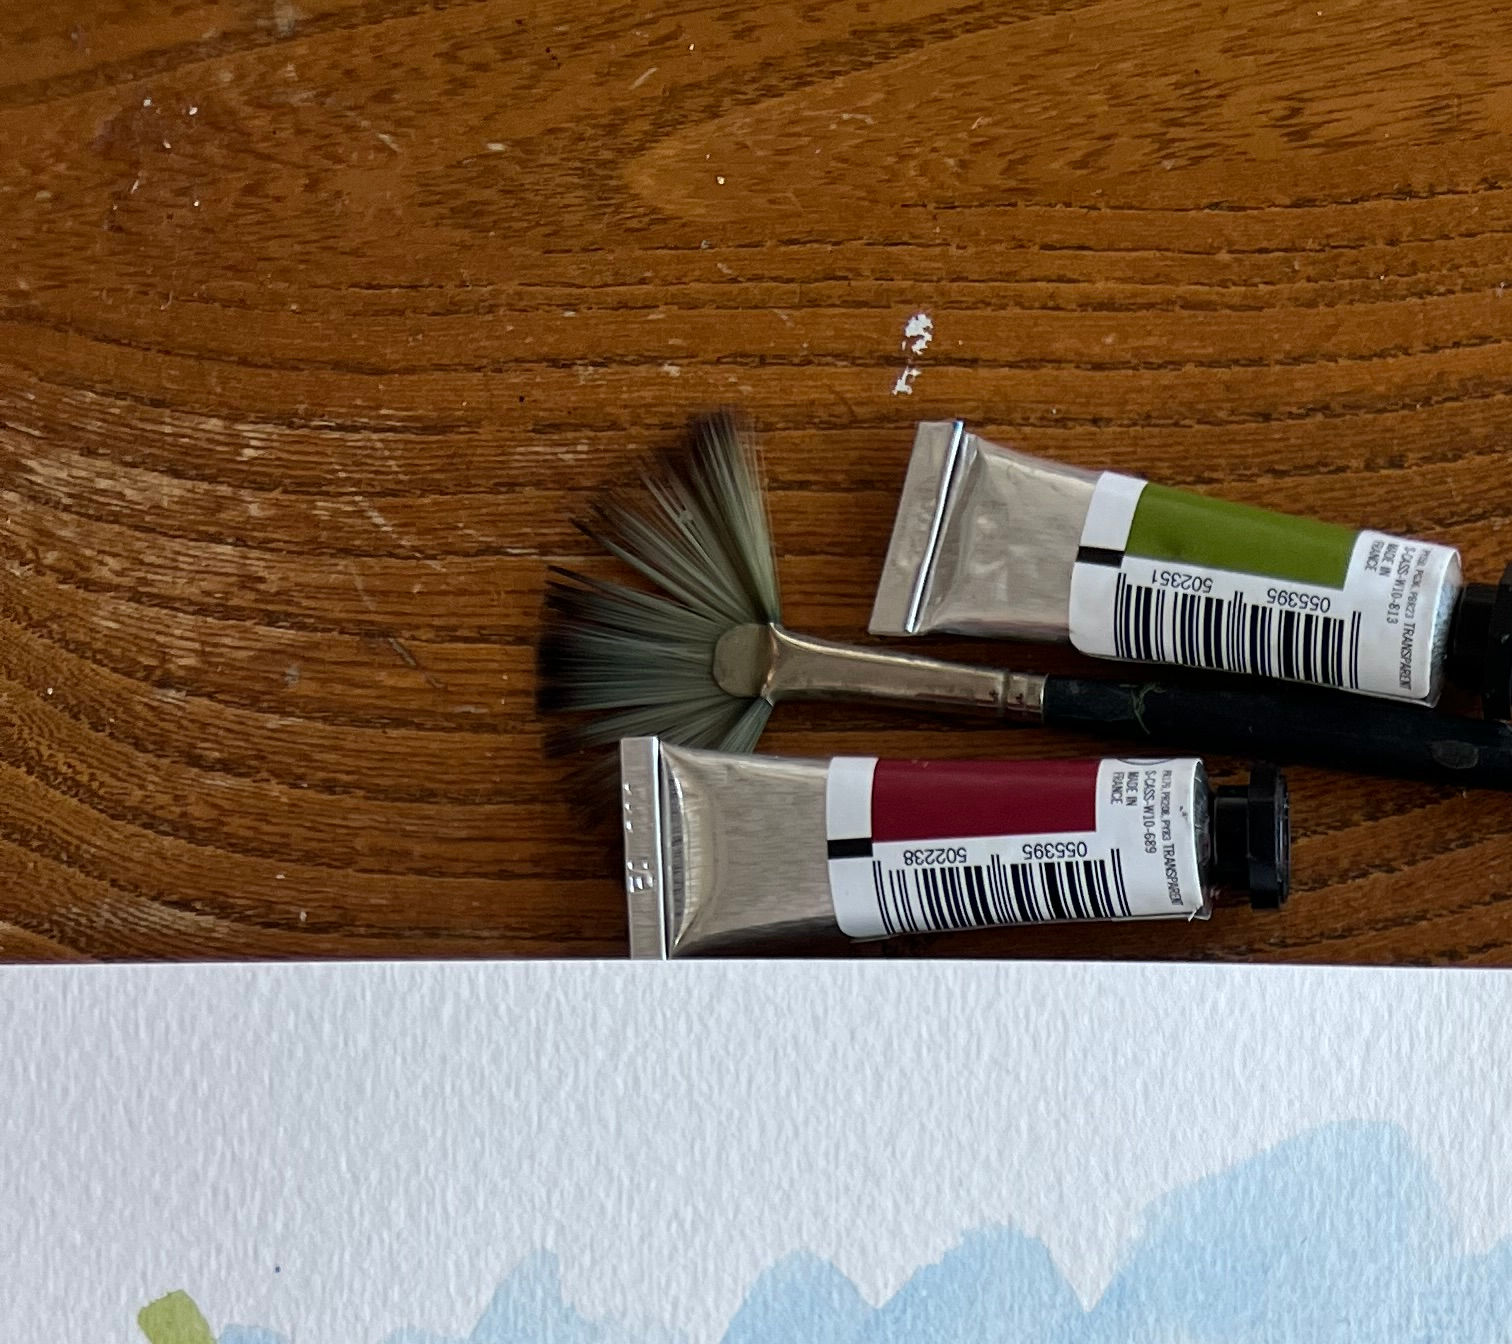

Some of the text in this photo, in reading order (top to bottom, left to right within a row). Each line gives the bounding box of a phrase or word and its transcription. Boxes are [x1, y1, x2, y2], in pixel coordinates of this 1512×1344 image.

[1399, 622, 1416, 691] TRANSPARENT
[1111, 771, 1125, 806] FRANCE
[1126, 771, 1139, 793] MADE
[903, 841, 1088, 866] 055395 502238
[1163, 843, 1184, 906] TRANSPARENT
